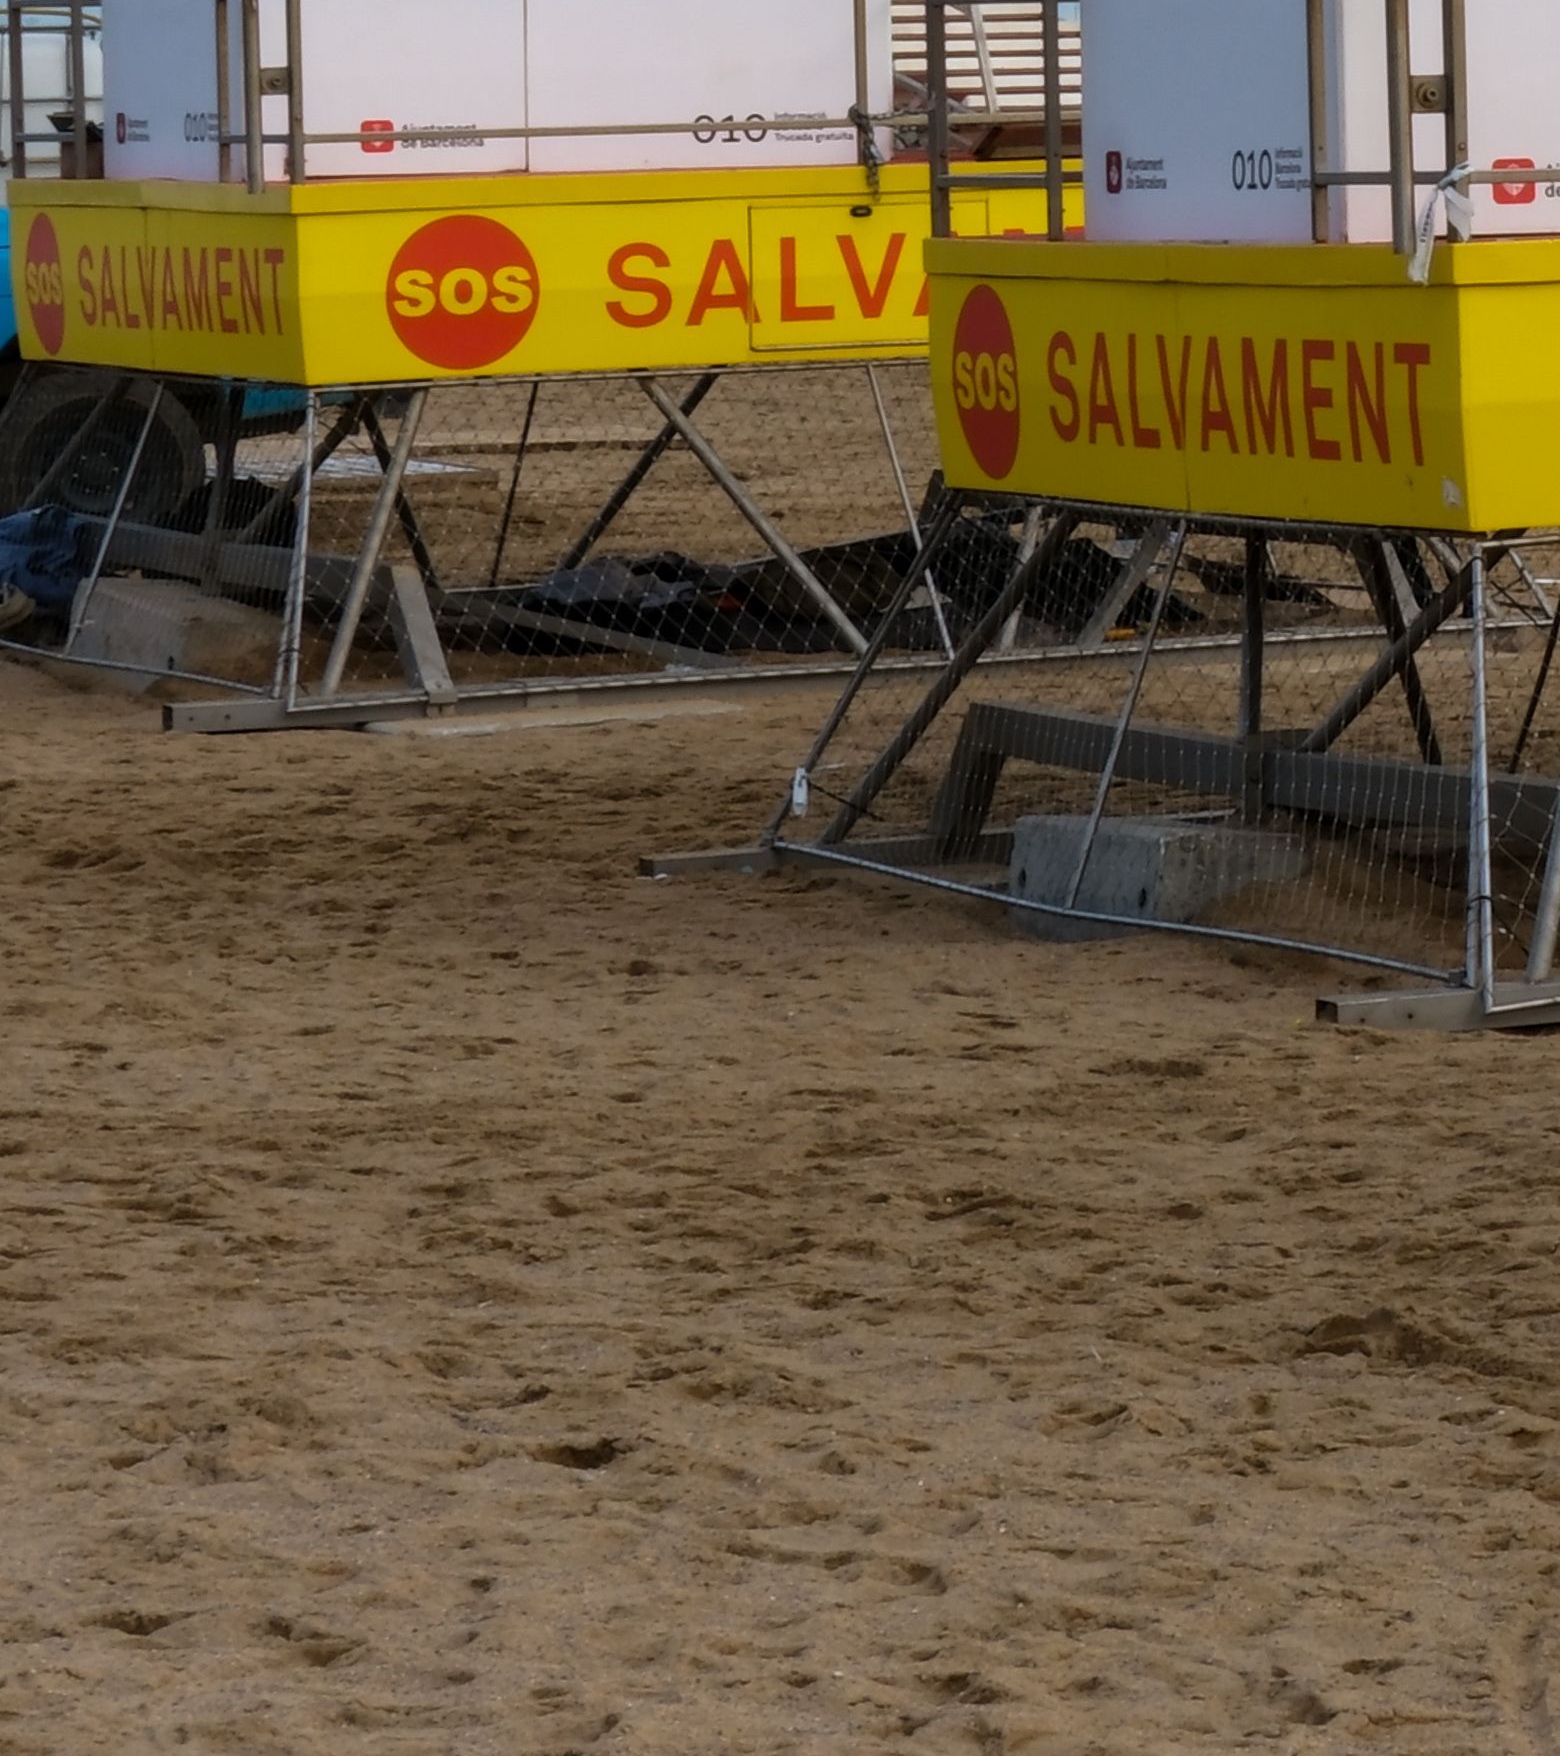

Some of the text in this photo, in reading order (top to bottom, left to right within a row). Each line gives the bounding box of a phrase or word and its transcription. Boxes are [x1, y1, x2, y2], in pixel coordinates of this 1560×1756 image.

[693, 114, 767, 143] 010
[1232, 149, 1272, 190] 010
[26, 245, 284, 336] SOS SALVAMENT
[393, 232, 930, 328] SOS SALV
[954, 330, 1431, 467] SOS SALVAMENT
